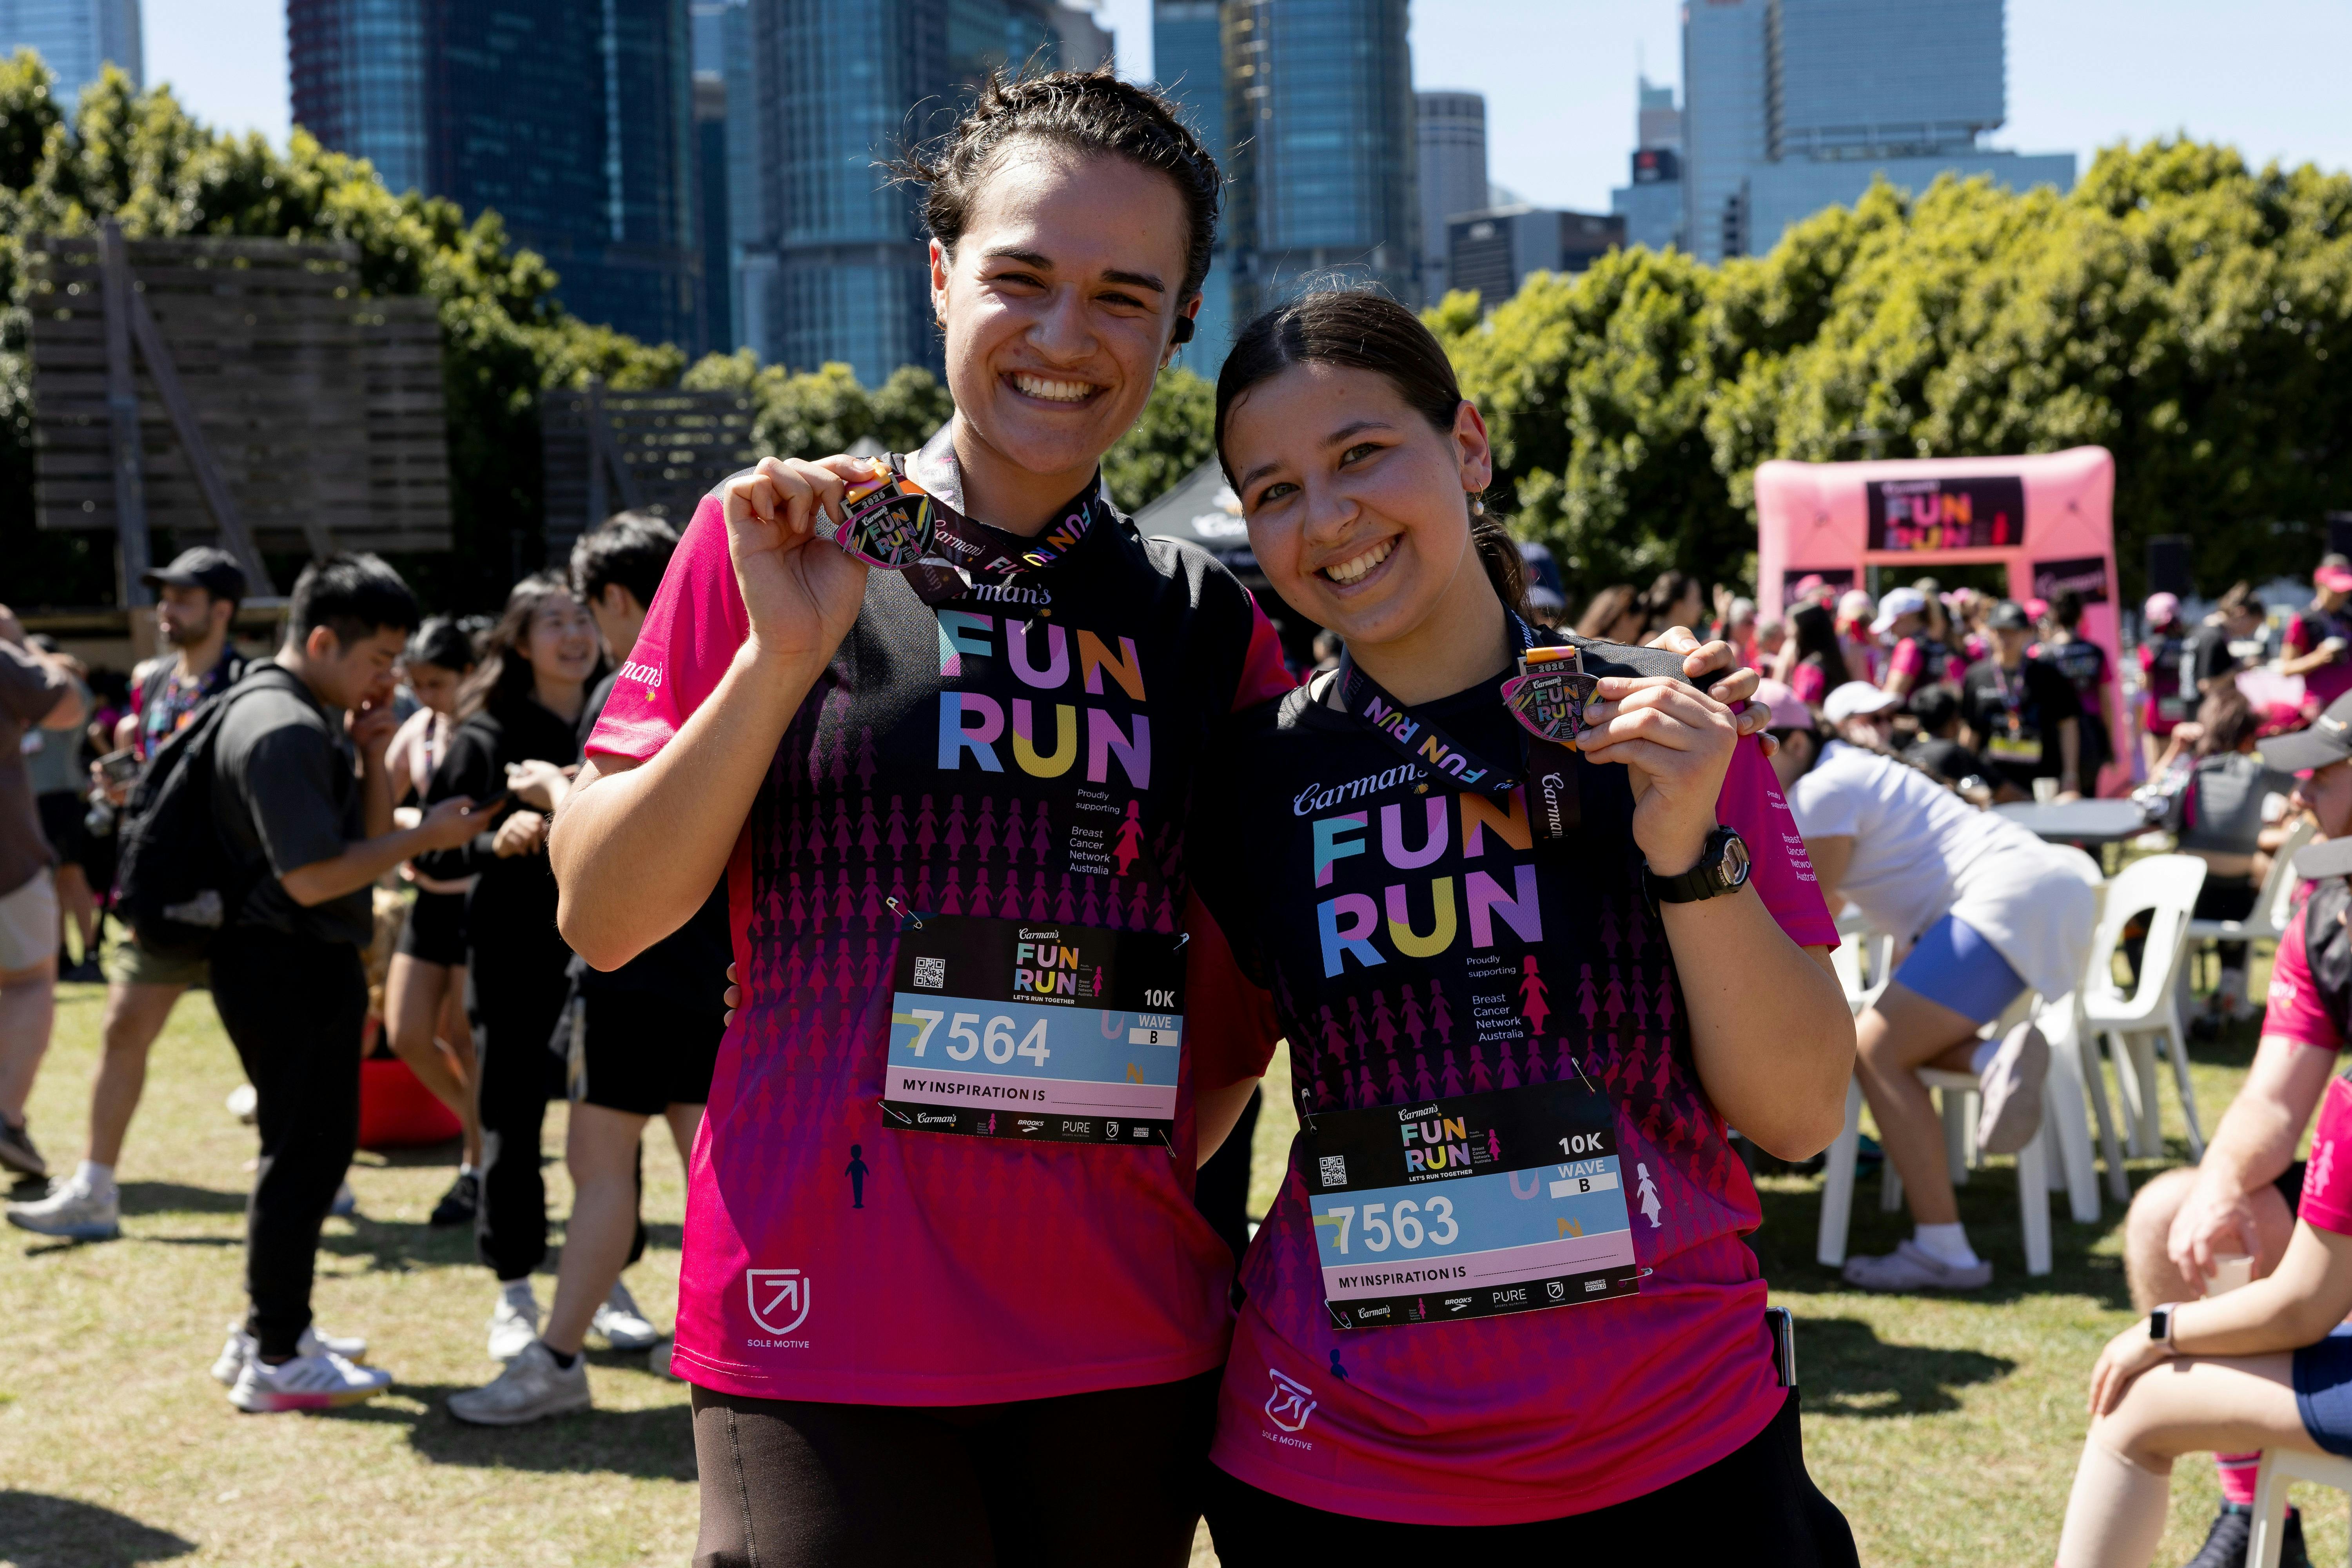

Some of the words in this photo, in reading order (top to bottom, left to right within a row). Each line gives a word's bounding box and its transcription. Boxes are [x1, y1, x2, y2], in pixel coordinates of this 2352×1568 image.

[862, 491, 885, 509] 2025
[862, 506, 888, 526] Carman's
[867, 507, 909, 540] FUN
[1047, 502, 1091, 553] FUN
[875, 522, 918, 555] RUN
[985, 556, 1029, 574] FU
[938, 609, 1146, 701] FUN
[1539, 662, 1564, 673] 2025
[1532, 676, 1562, 689] Carman's
[1535, 684, 1579, 705] FUN
[1363, 696, 1420, 744] RUN
[1537, 701, 1581, 722] RUN
[938, 691, 1151, 790] RUN
[1417, 735, 1488, 784] FUN
[1078, 789, 1109, 800] Proudly
[1076, 803, 1120, 814] supporting
[1072, 826, 1103, 838] Breast
[1313, 785, 1533, 889] FUN
[1782, 833, 1801, 843] Breast
[1070, 838, 1104, 849] Cancer
[1786, 846, 1806, 856] Cancer
[1070, 850, 1110, 862] Network
[1070, 863, 1109, 875] Australia
[1717, 866, 1728, 886] BABY-G
[1796, 871, 1817, 881] Austral
[1317, 864, 1543, 978] RUN
[1019, 928, 1059, 939] Carman's
[1016, 943, 1079, 969] FUN
[1467, 955, 1500, 965] Proudly
[1469, 967, 1516, 978] supporting
[1014, 968, 1076, 995] RUN
[1145, 989, 1175, 1007] 10K
[1473, 994, 1506, 1004] Breast
[1474, 1007, 1510, 1016] Cancer
[1139, 1014, 1172, 1029] WAVE
[1476, 1016, 1521, 1029] Network
[911, 1009, 1051, 1067] 7564
[1150, 1030, 1158, 1044] B
[1479, 1029, 1523, 1042] Australia
[903, 1079, 927, 1091] MY
[930, 1081, 1029, 1100] INSPIRATION
[1033, 1090, 1045, 1101] IS
[918, 1112, 956, 1123] Carman's
[1399, 1104, 1438, 1121] Carman's
[1063, 1121, 1090, 1132] PURE
[1401, 1117, 1466, 1147] FUN
[1559, 1132, 1604, 1155] 10K
[1405, 1143, 1471, 1172] RUN
[1440, 1169, 1473, 1178] TOGETHER
[1557, 1159, 1605, 1178] WAVE
[1579, 1178, 1590, 1193] B
[1328, 1196, 1459, 1254] 7563
[1339, 1276, 1358, 1288] MY
[1361, 1268, 1450, 1287] INSPIRATION
[1452, 1266, 1466, 1278] IS
[1493, 1289, 1527, 1303] PURE
[1358, 1305, 1390, 1319] Carman's
[747, 1339, 771, 1347] SOLE
[774, 1340, 809, 1348] MOTIVE
[1262, 1430, 1278, 1442] SOLE
[1279, 1436, 1312, 1450] MOTIVE
